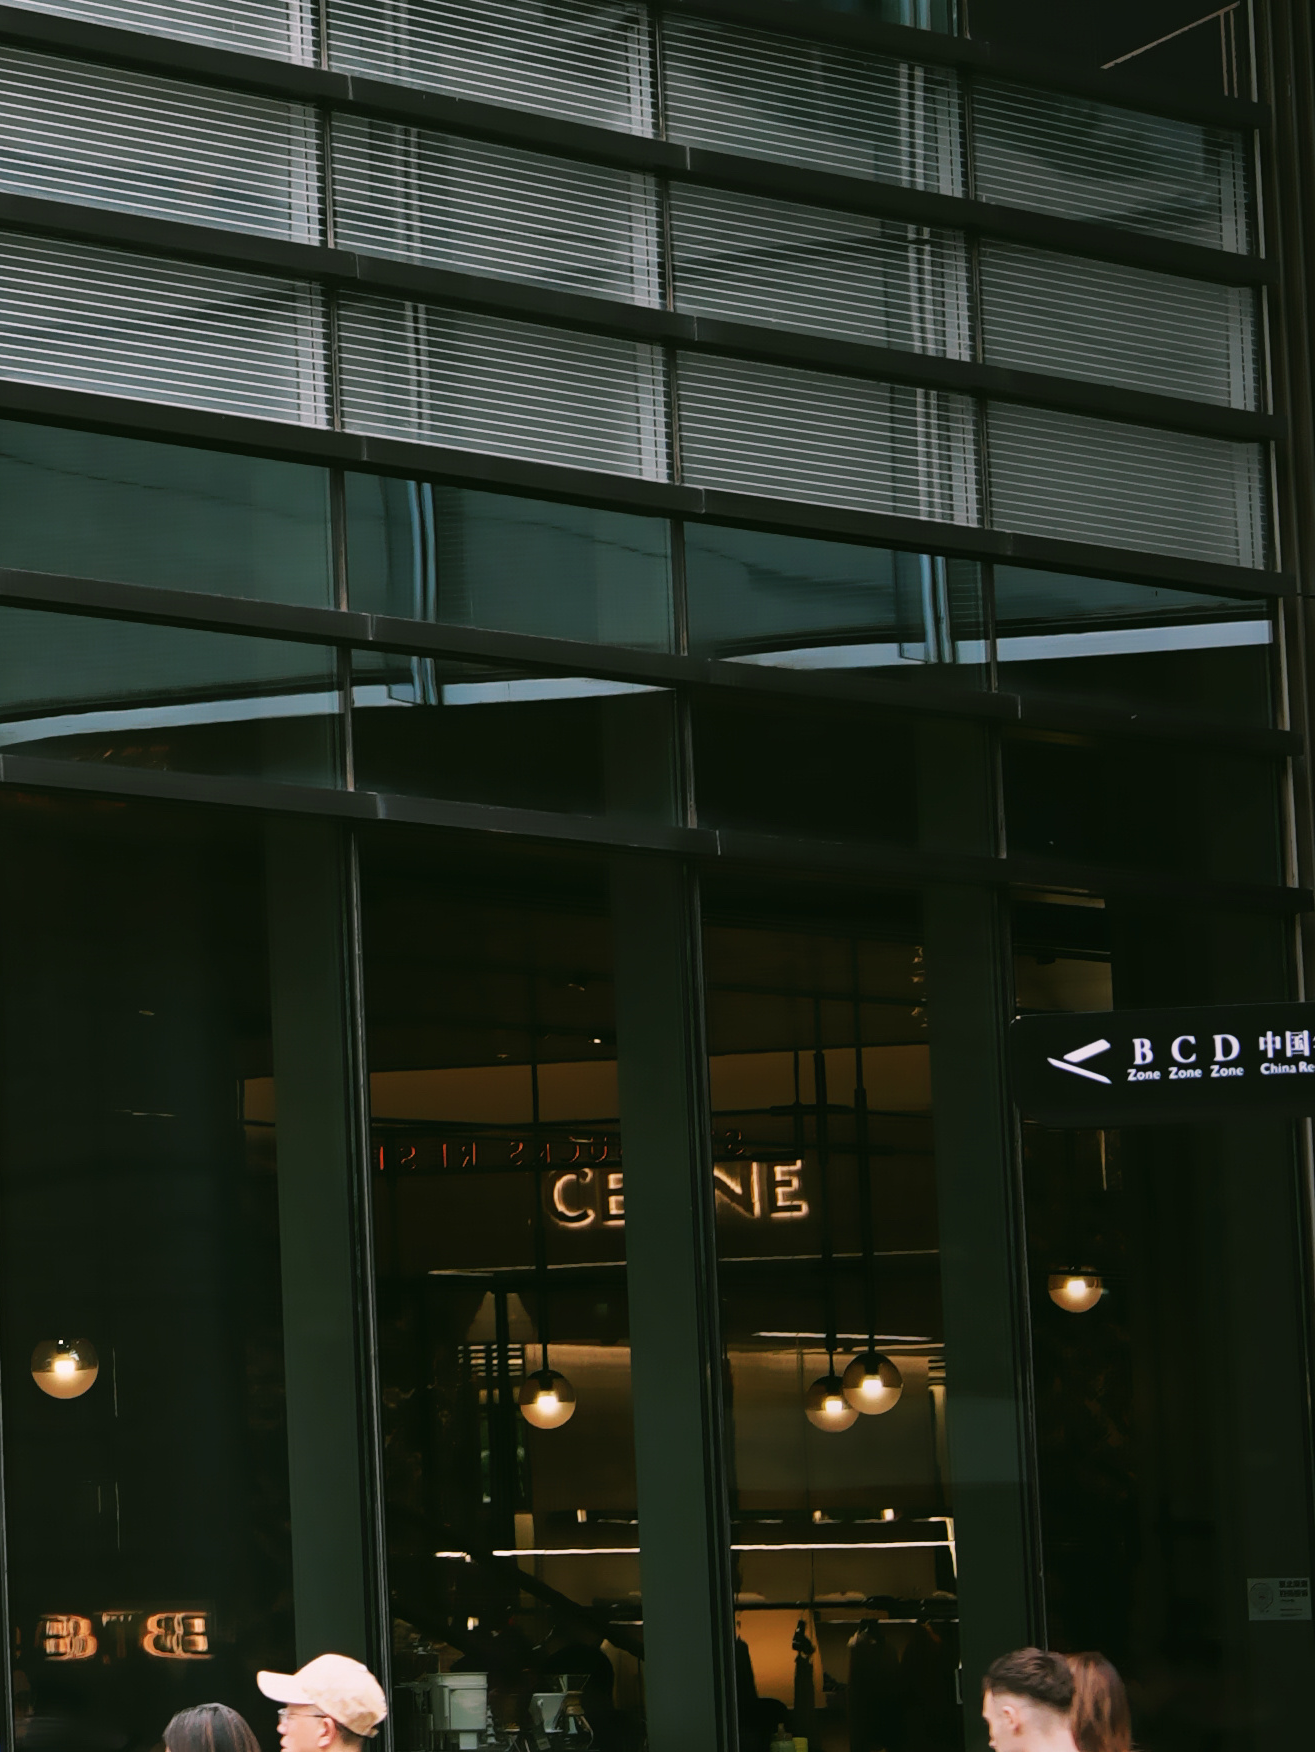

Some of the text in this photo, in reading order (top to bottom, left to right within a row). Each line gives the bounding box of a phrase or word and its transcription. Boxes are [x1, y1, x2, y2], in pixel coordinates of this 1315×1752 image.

[1132, 1029, 1315, 1066] B C D 中国
[1127, 1067, 1161, 1082] Zone
[1168, 1065, 1203, 1080] Zone
[1210, 1064, 1244, 1078] Zone
[1260, 1062, 1297, 1075] China
[550, 1160, 810, 1227] CENE
